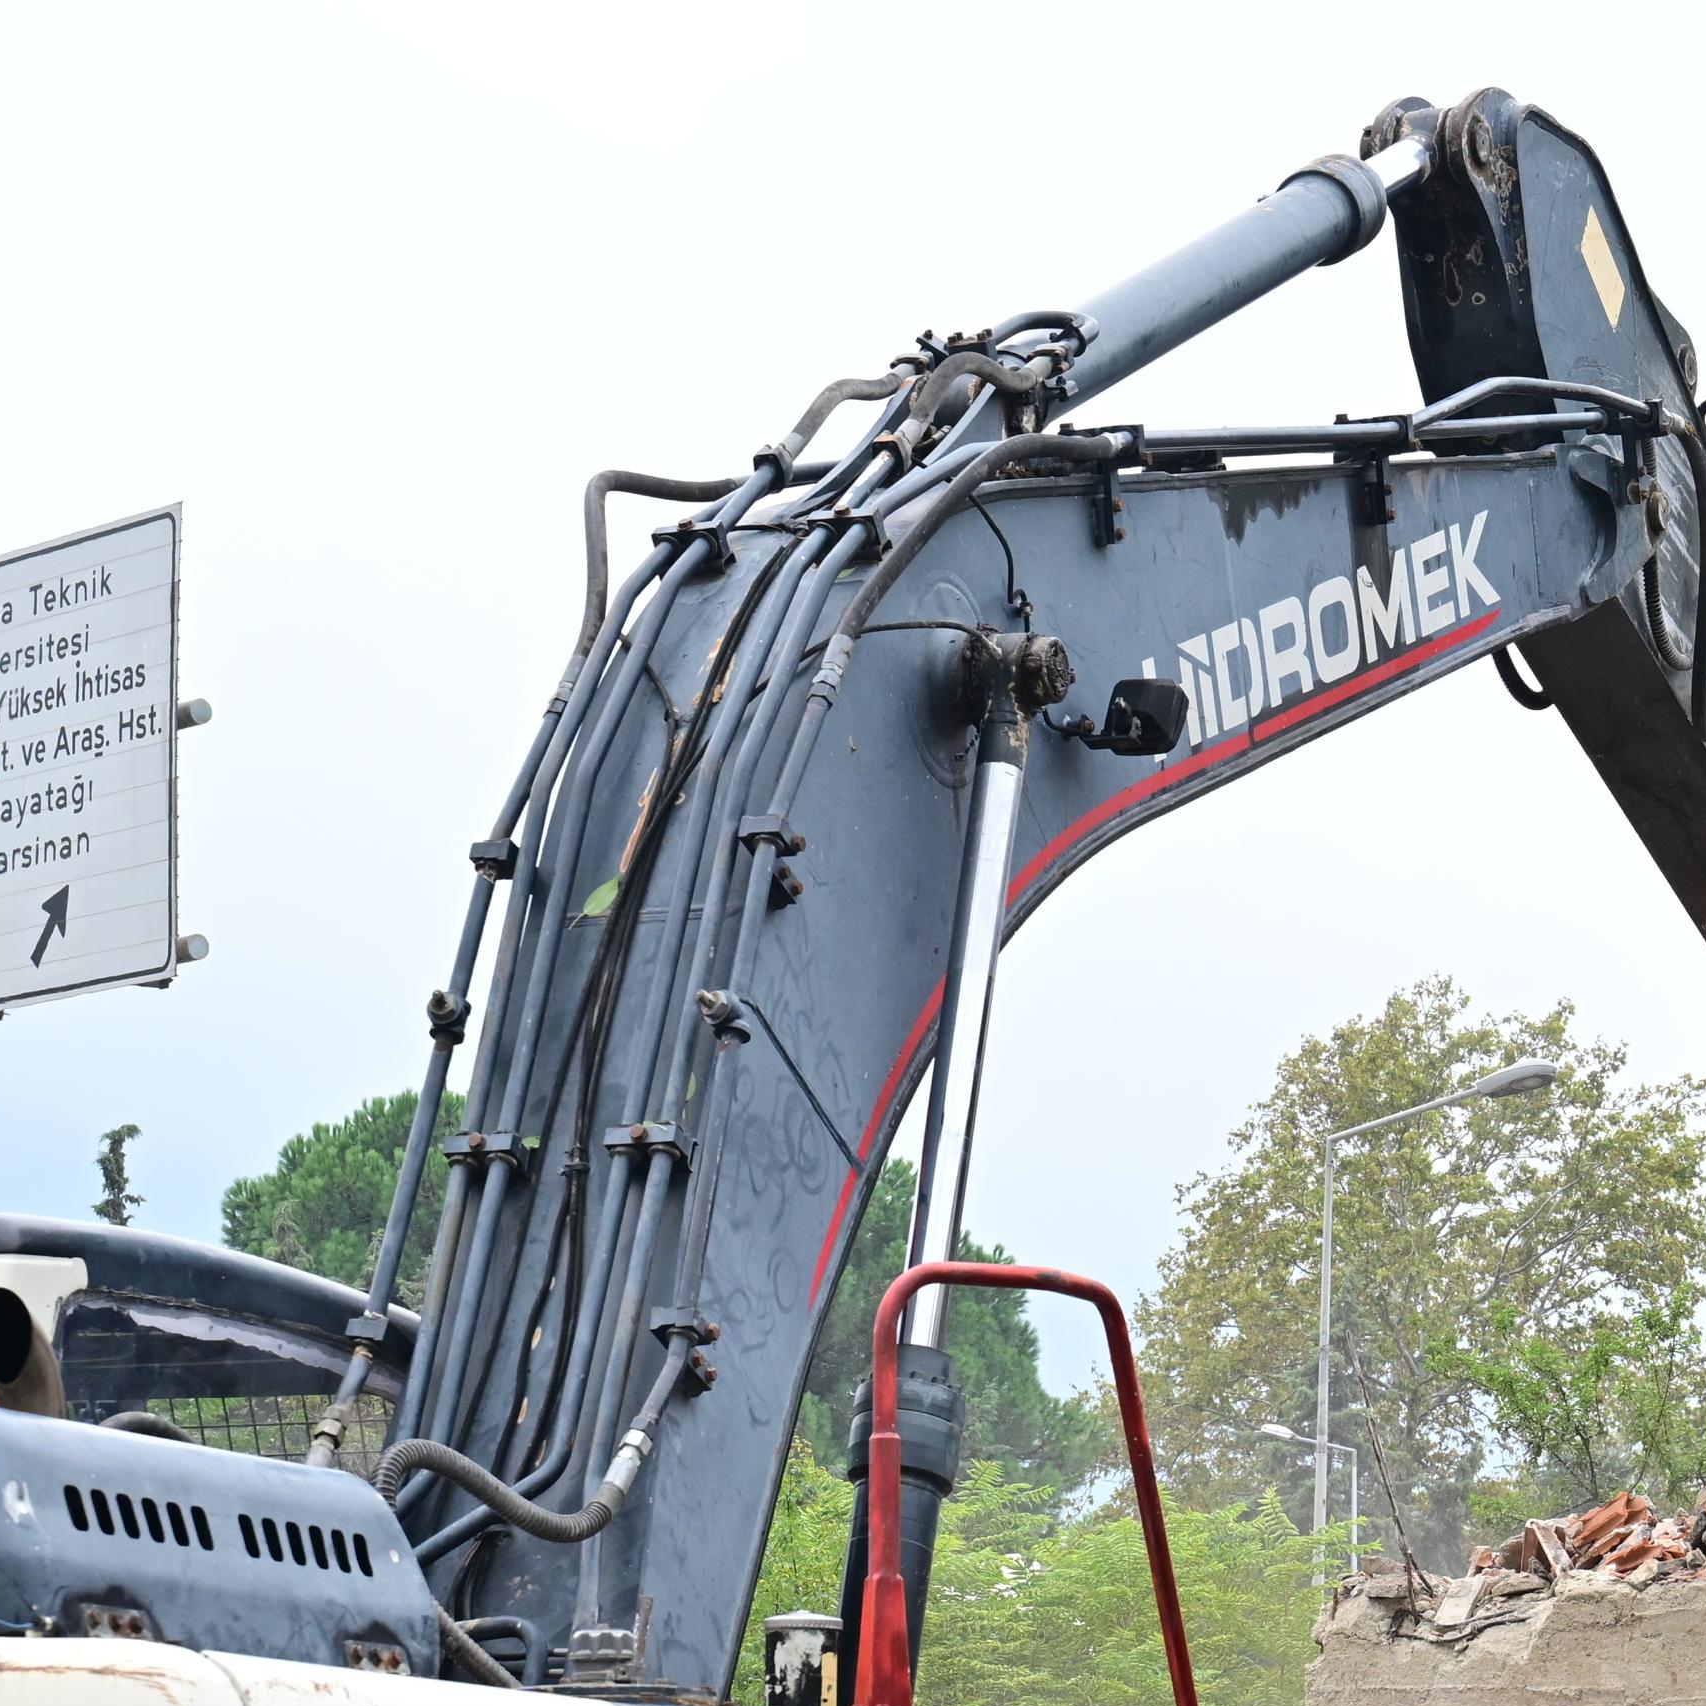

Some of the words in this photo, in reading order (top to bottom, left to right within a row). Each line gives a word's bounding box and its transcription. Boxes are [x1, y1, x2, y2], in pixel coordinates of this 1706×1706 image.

[29, 565, 113, 615] Teknik
[75, 660, 146, 703] İhtisas
[22, 739, 46, 766] ve
[53, 724, 110, 760] Araş.
[119, 704, 162, 743] Hst.
